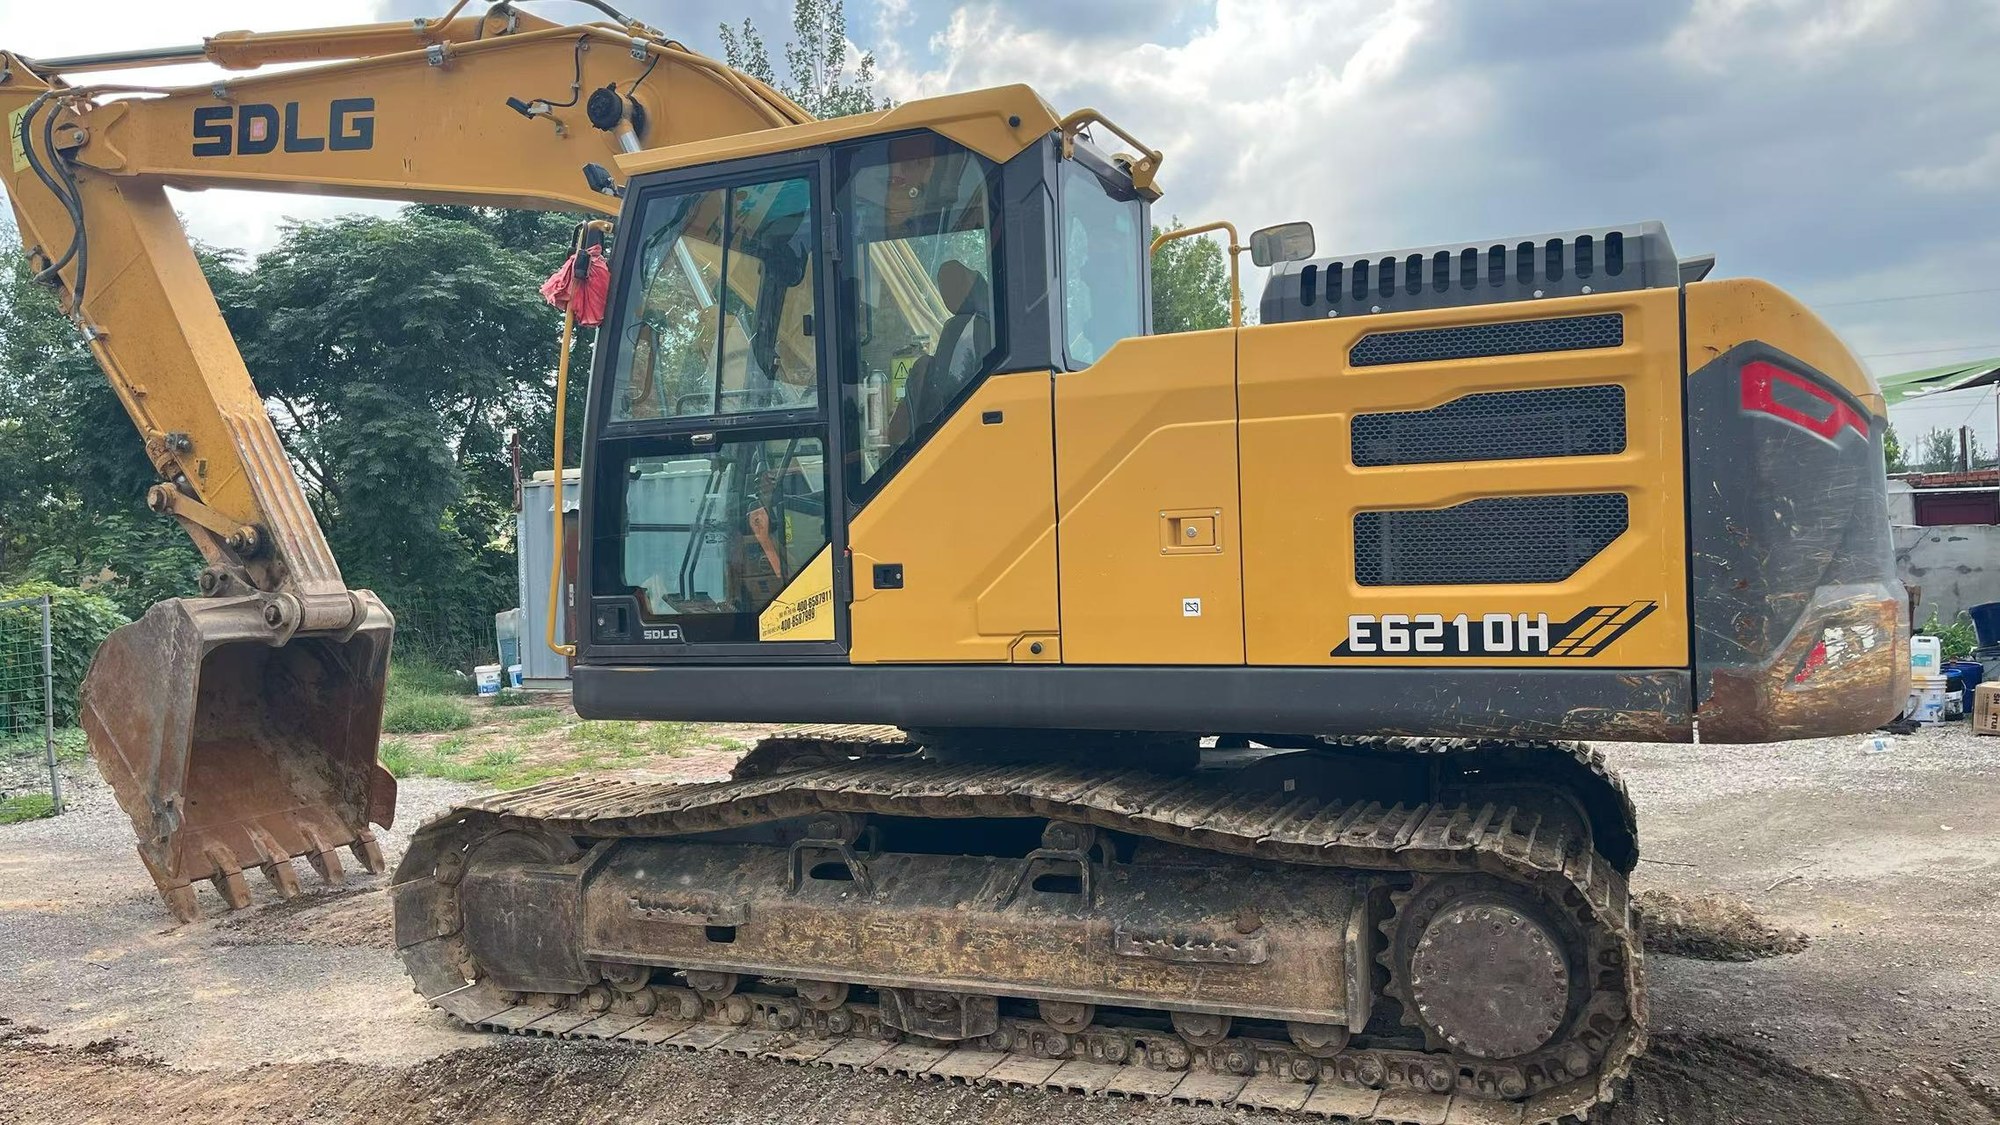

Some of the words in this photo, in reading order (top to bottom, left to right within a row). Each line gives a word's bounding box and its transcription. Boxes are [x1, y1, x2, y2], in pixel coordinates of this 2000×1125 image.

[192, 97, 375, 157] SDLG
[643, 629, 678, 640] SDLG
[1348, 612, 1549, 652] E6210H
